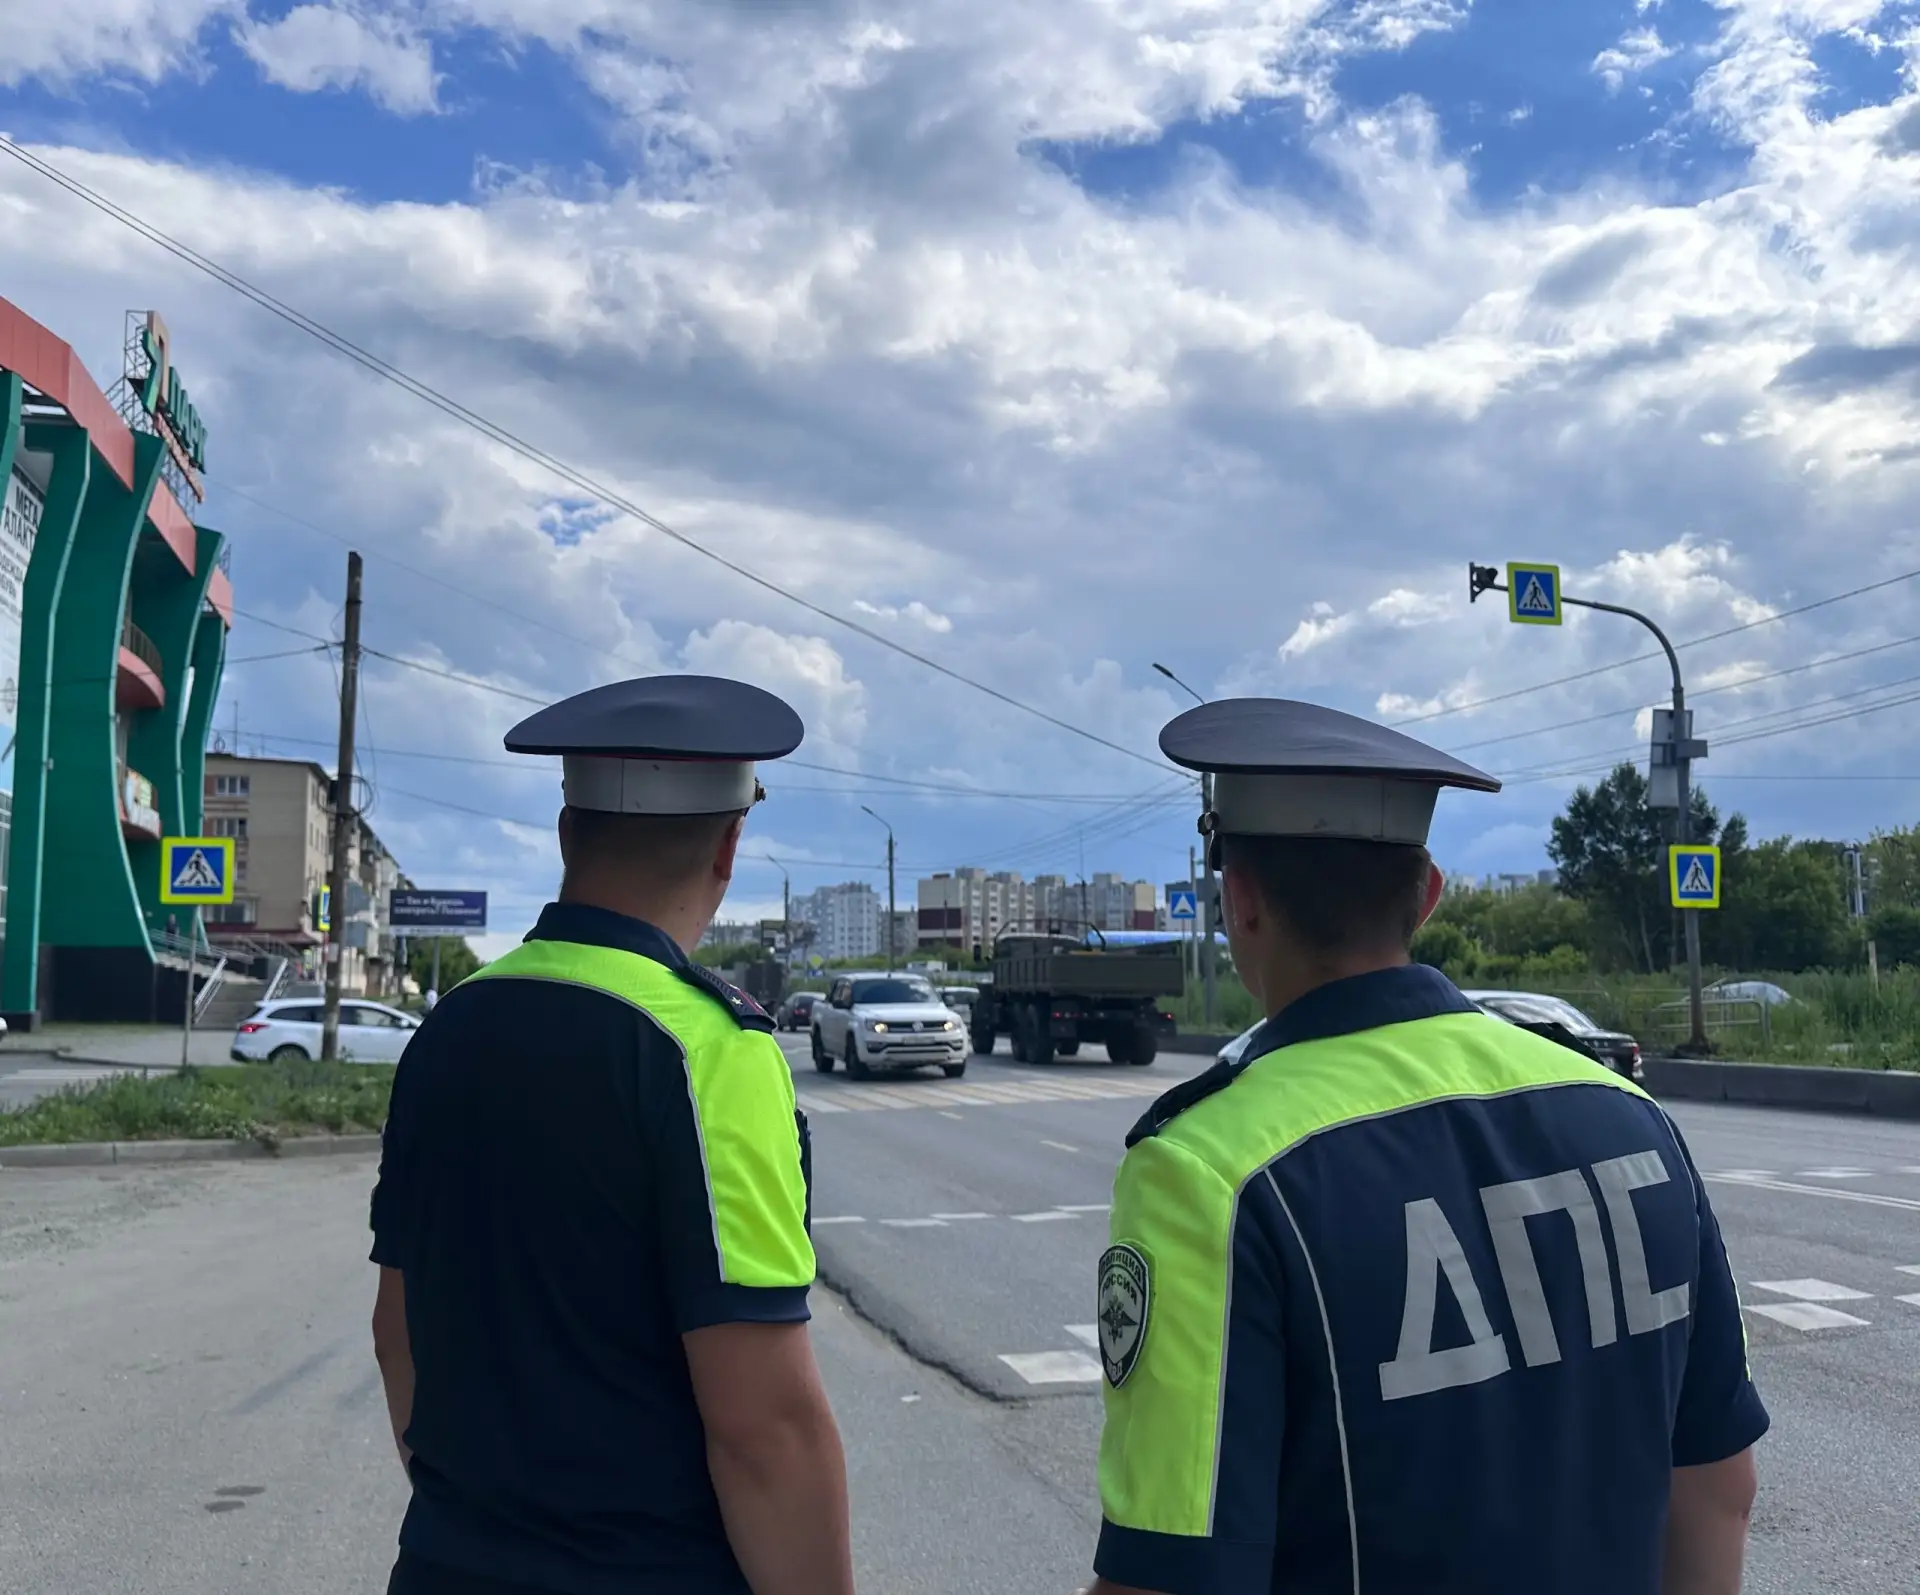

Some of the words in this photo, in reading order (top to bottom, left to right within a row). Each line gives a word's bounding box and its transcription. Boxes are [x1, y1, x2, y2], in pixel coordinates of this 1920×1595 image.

[15, 485, 39, 527] МЕГА
[1100, 1251, 1141, 1283] ПОЛИЦИЯ
[1379, 1150, 1690, 1401] ДПС
[1102, 1273, 1138, 1306] РОССИЯ
